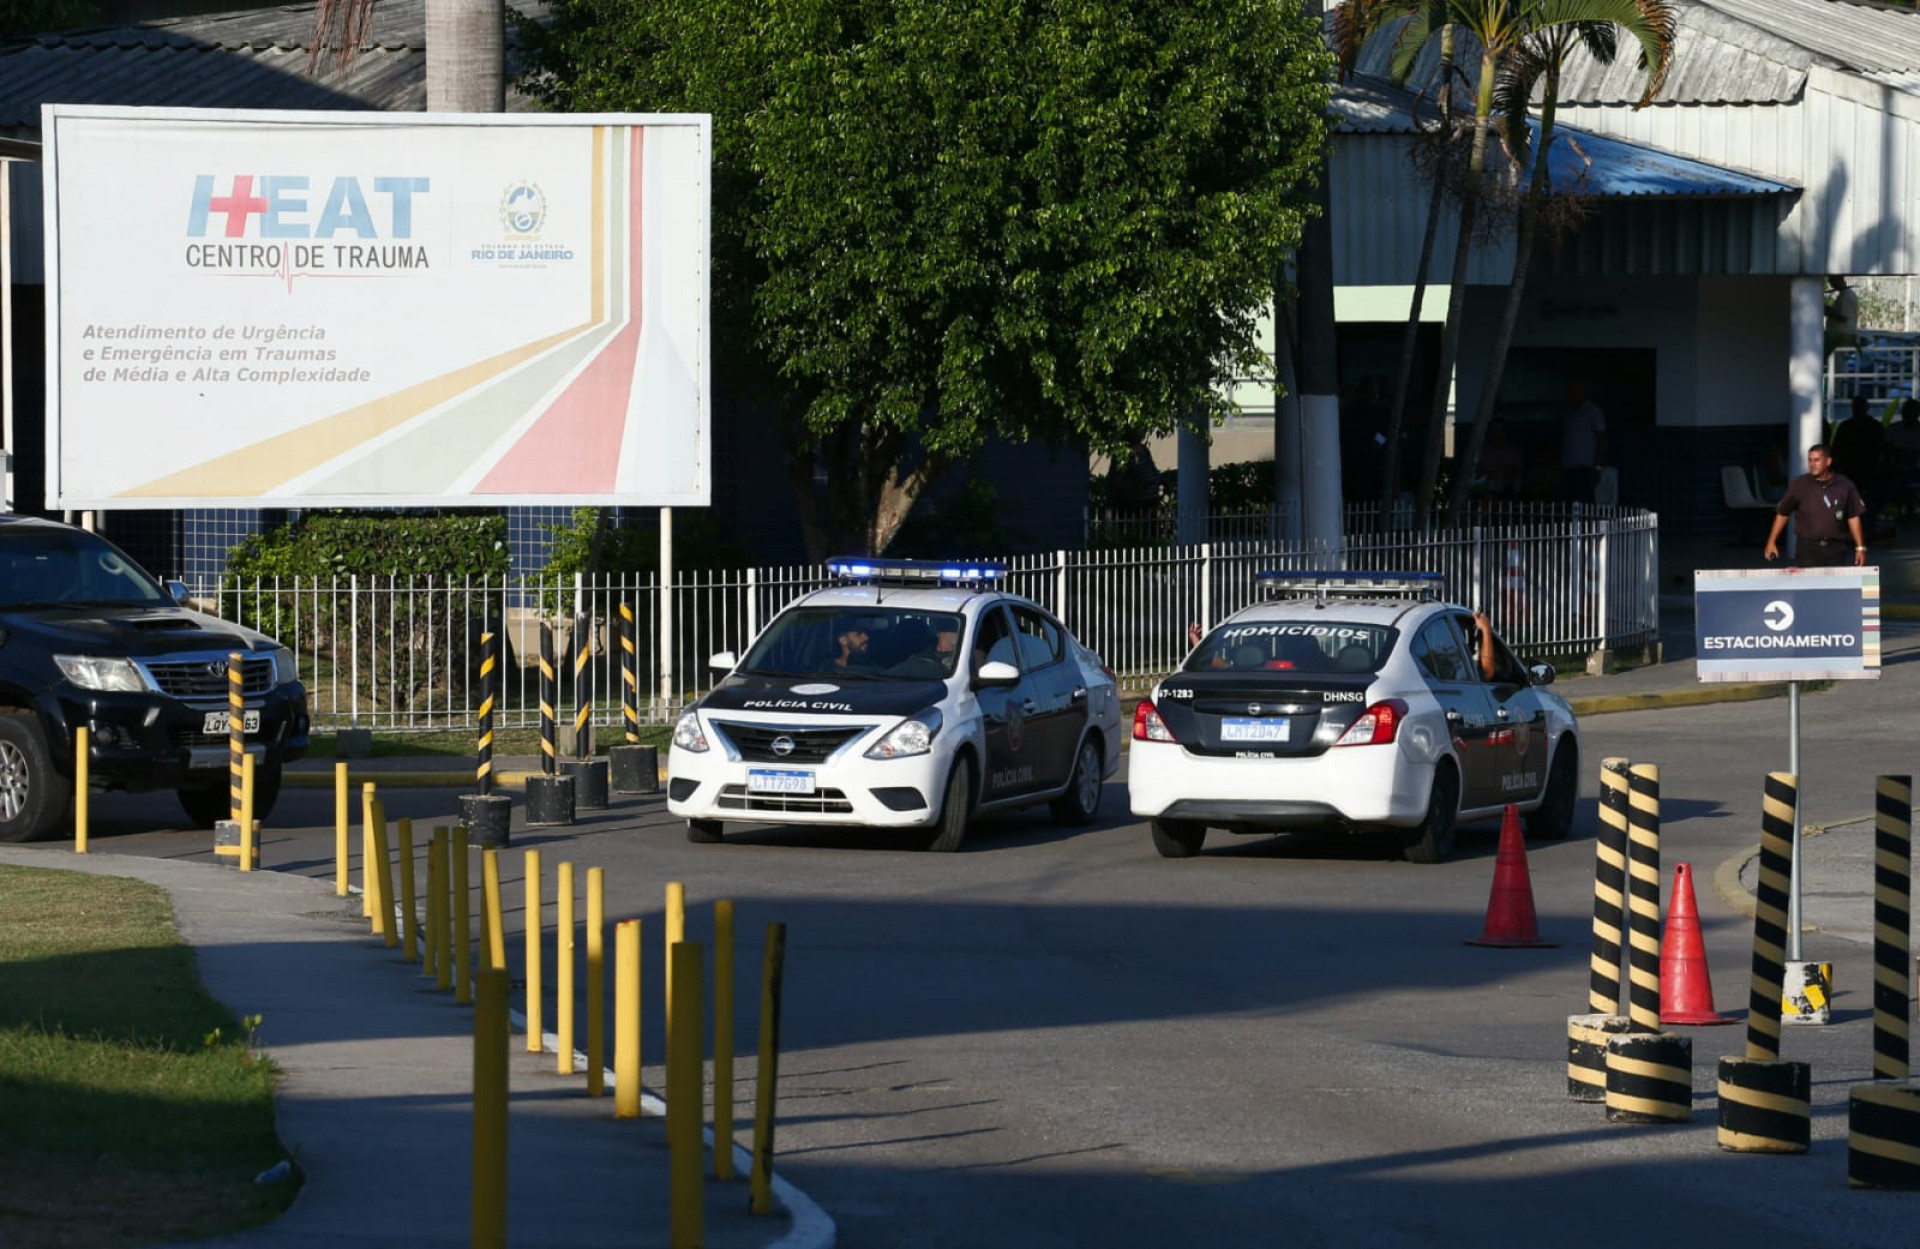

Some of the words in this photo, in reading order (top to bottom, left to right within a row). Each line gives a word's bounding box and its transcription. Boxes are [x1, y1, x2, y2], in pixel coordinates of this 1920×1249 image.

[187, 175, 430, 239] HEAT
[186, 244, 281, 268] CENTRO
[295, 246, 325, 268] DE
[334, 245, 430, 269] TRAUMA
[471, 250, 494, 260] RIO
[497, 250, 515, 260] DE
[518, 250, 574, 260] JANEIRO
[82, 324, 206, 339] Atendimento
[213, 325, 235, 339] de
[242, 324, 326, 343] Urgência
[83, 348, 95, 361] e
[101, 345, 212, 364] Emergência
[219, 348, 247, 361] em
[255, 347, 337, 361] Traumas
[83, 367, 106, 382] de
[113, 366, 169, 382] Média
[175, 370, 186, 382] e
[192, 367, 230, 382] Alta
[237, 367, 371, 385] Complexidade
[1223, 625, 1370, 640] HOMICÍDIOS
[1704, 634, 1855, 649] ESTACIONAMENTO
[743, 700, 807, 709] POLÍCIA
[811, 701, 853, 711] CIVIL
[1323, 692, 1364, 702] DHNSG
